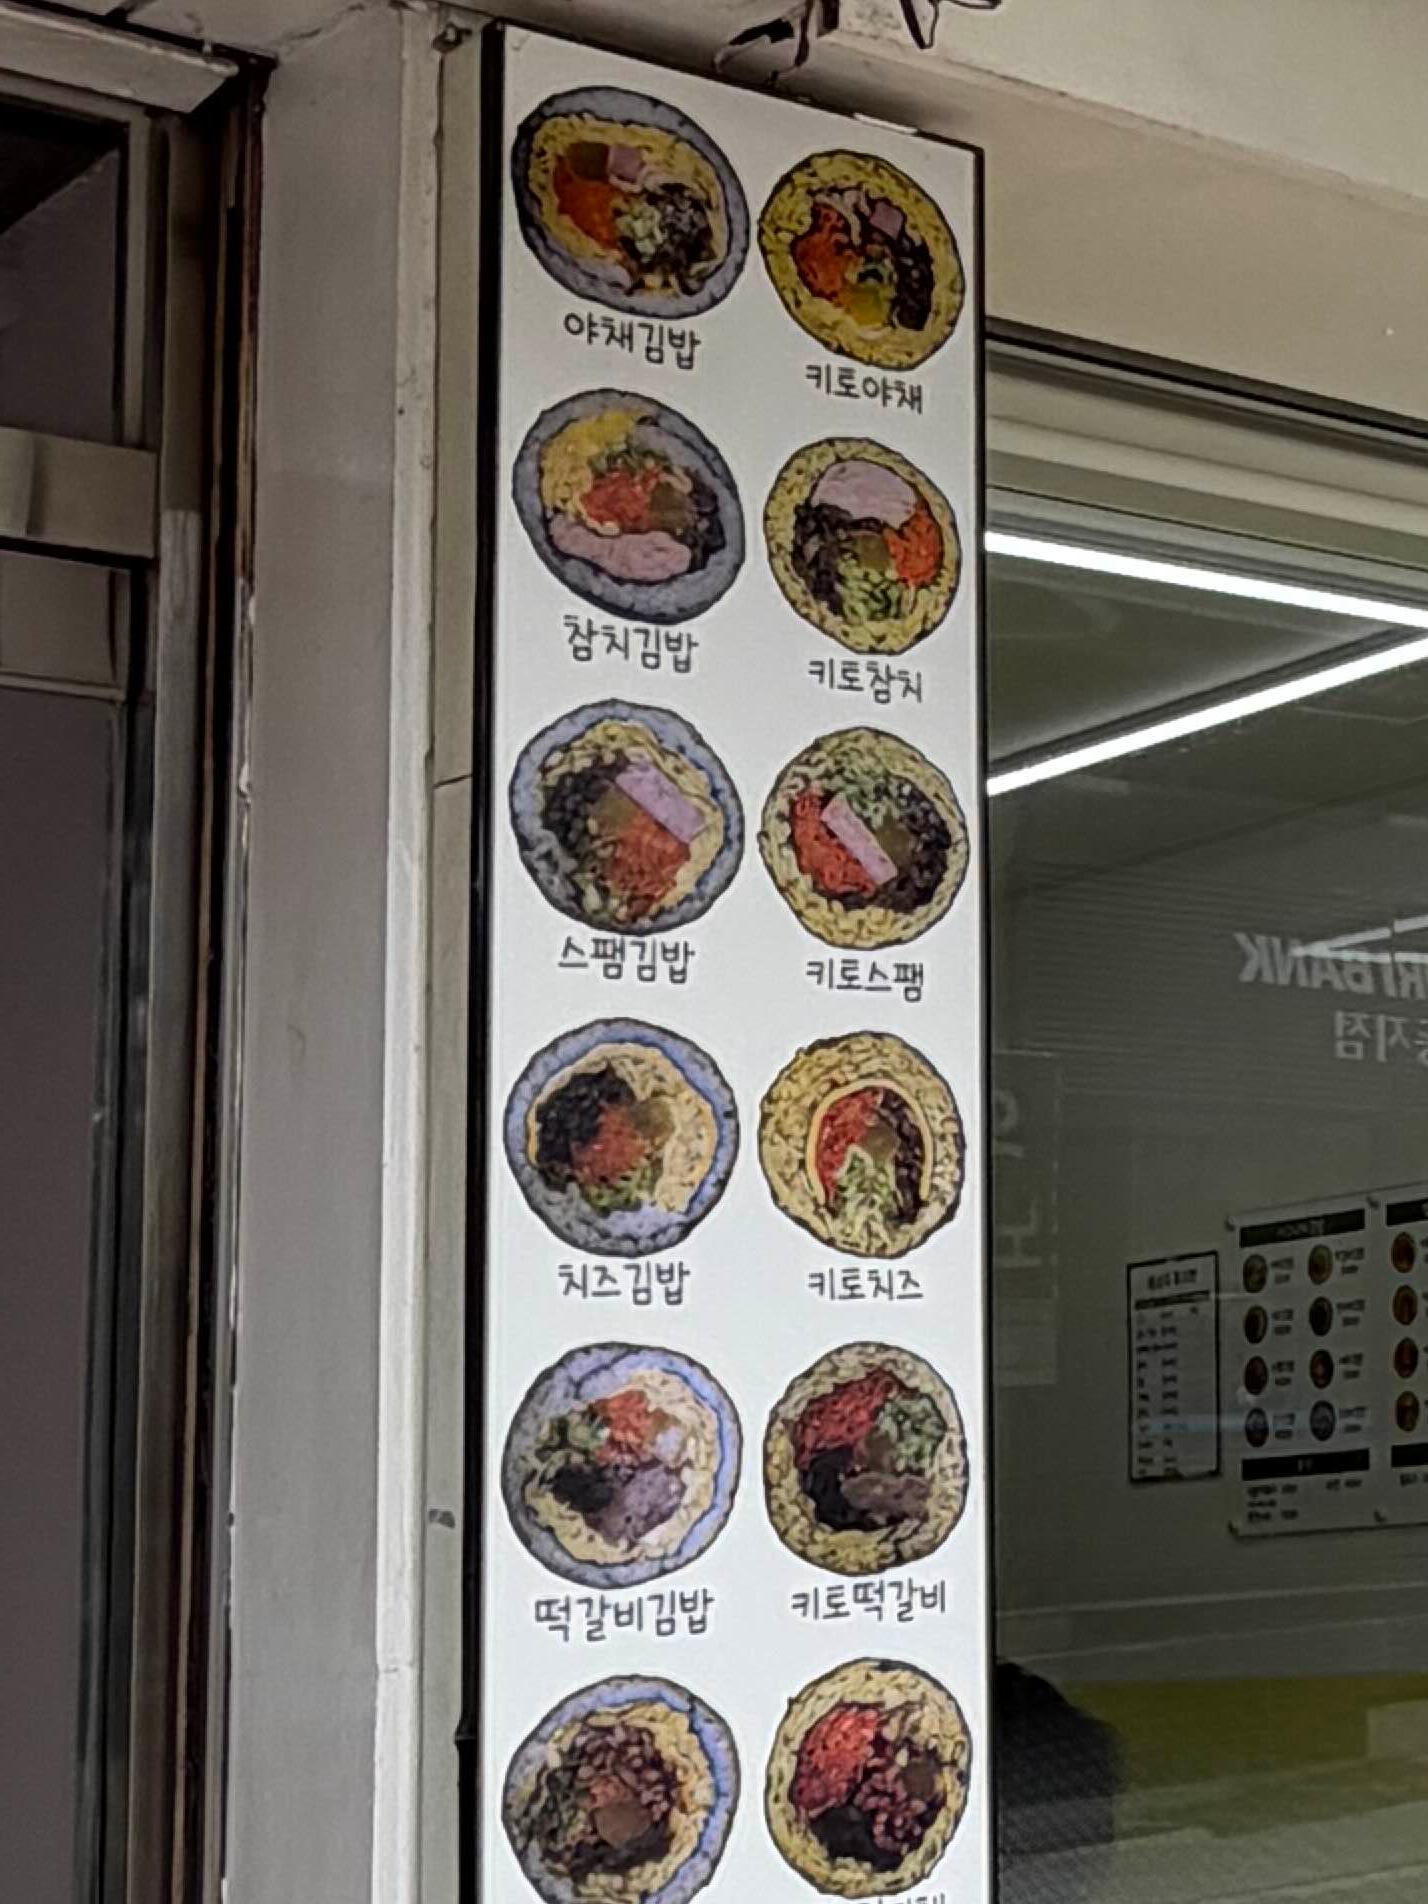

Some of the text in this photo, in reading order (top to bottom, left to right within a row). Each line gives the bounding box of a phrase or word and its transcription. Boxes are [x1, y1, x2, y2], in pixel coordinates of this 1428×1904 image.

[564, 310, 701, 369] 야채김밥
[805, 363, 923, 414] 키토야채
[564, 615, 698, 673] 참치김밥
[807, 658, 923, 705] 키토참치
[558, 936, 695, 984] 스팸김밥
[805, 958, 925, 1003] 키토스팸
[558, 1259, 690, 1305] 치즈김밥
[807, 1266, 924, 1304] 키토치즈
[534, 1590, 715, 1642] 떡갈비김밥
[791, 1577, 946, 1625] 키토떡갈비
